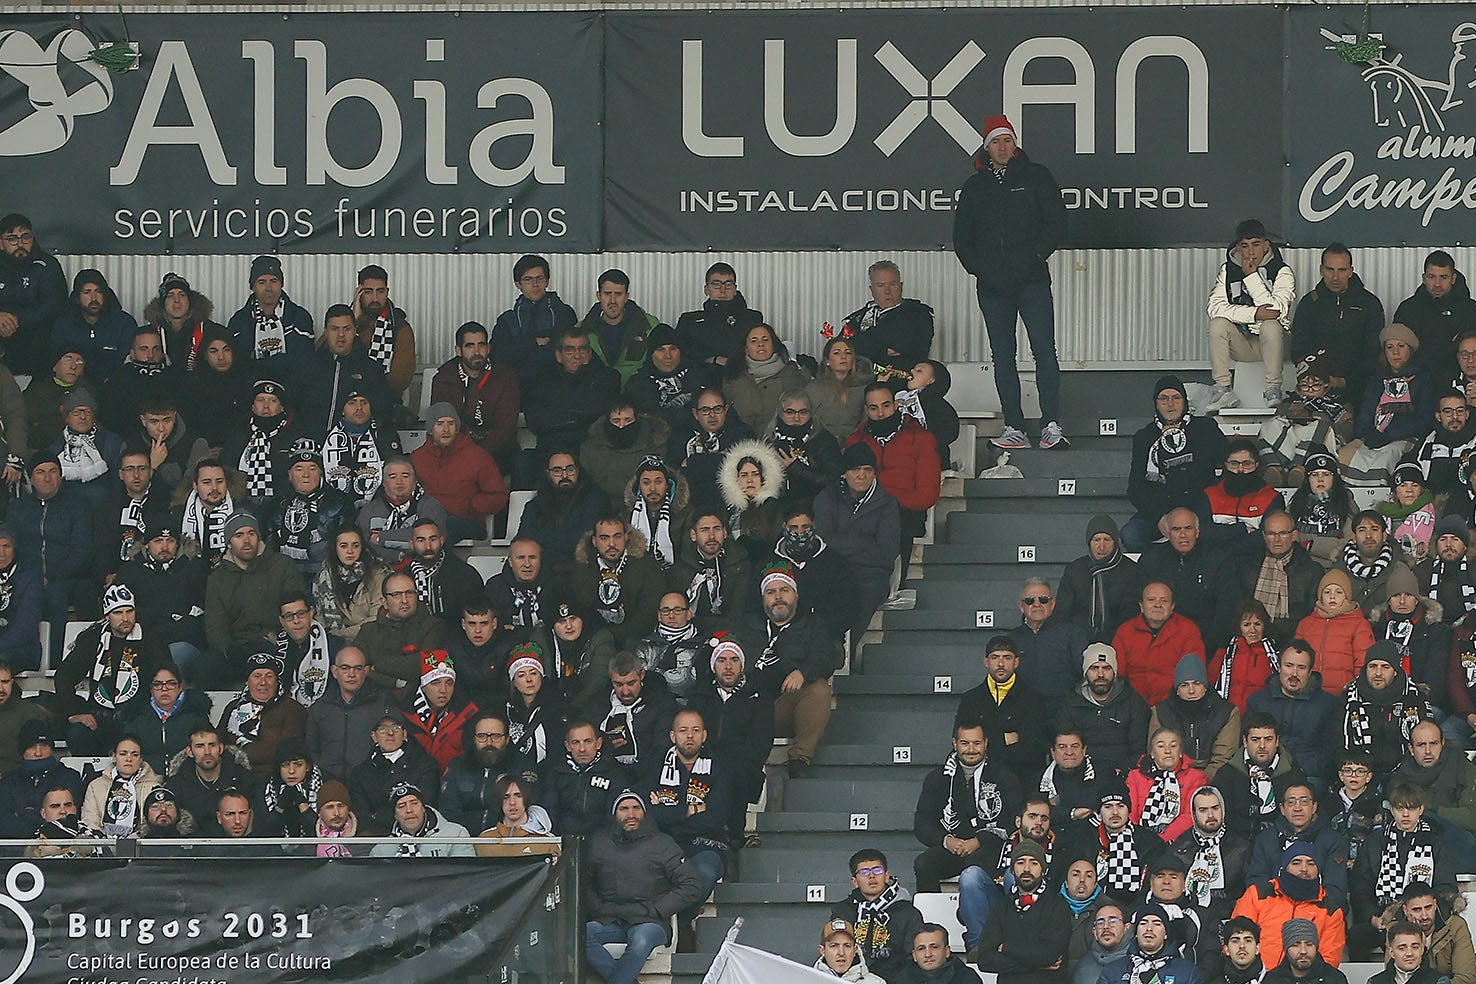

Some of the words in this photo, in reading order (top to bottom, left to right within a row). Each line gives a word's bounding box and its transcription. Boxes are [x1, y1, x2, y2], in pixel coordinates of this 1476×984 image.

[683, 36, 1209, 157] LUXAN
[110, 40, 565, 187] Albia
[1061, 187, 1208, 209] ONTROL
[114, 208, 313, 239] servicios
[335, 198, 567, 238] funerarios
[1102, 423, 1114, 431] 18
[1061, 483, 1073, 492] 17
[1021, 550, 1033, 558] 16
[979, 615, 991, 623] 15
[937, 681, 949, 689] 14
[896, 751, 908, 759] 13
[591, 776, 609, 789] HH
[853, 818, 865, 826] 12
[810, 889, 821, 898] 11
[68, 914, 201, 944] Burgos
[223, 913, 313, 938] 2031
[67, 953, 131, 972] Capital
[138, 953, 210, 972] Europea
[217, 953, 238, 969] de
[246, 953, 260, 969] la
[267, 953, 331, 969] Cultura
